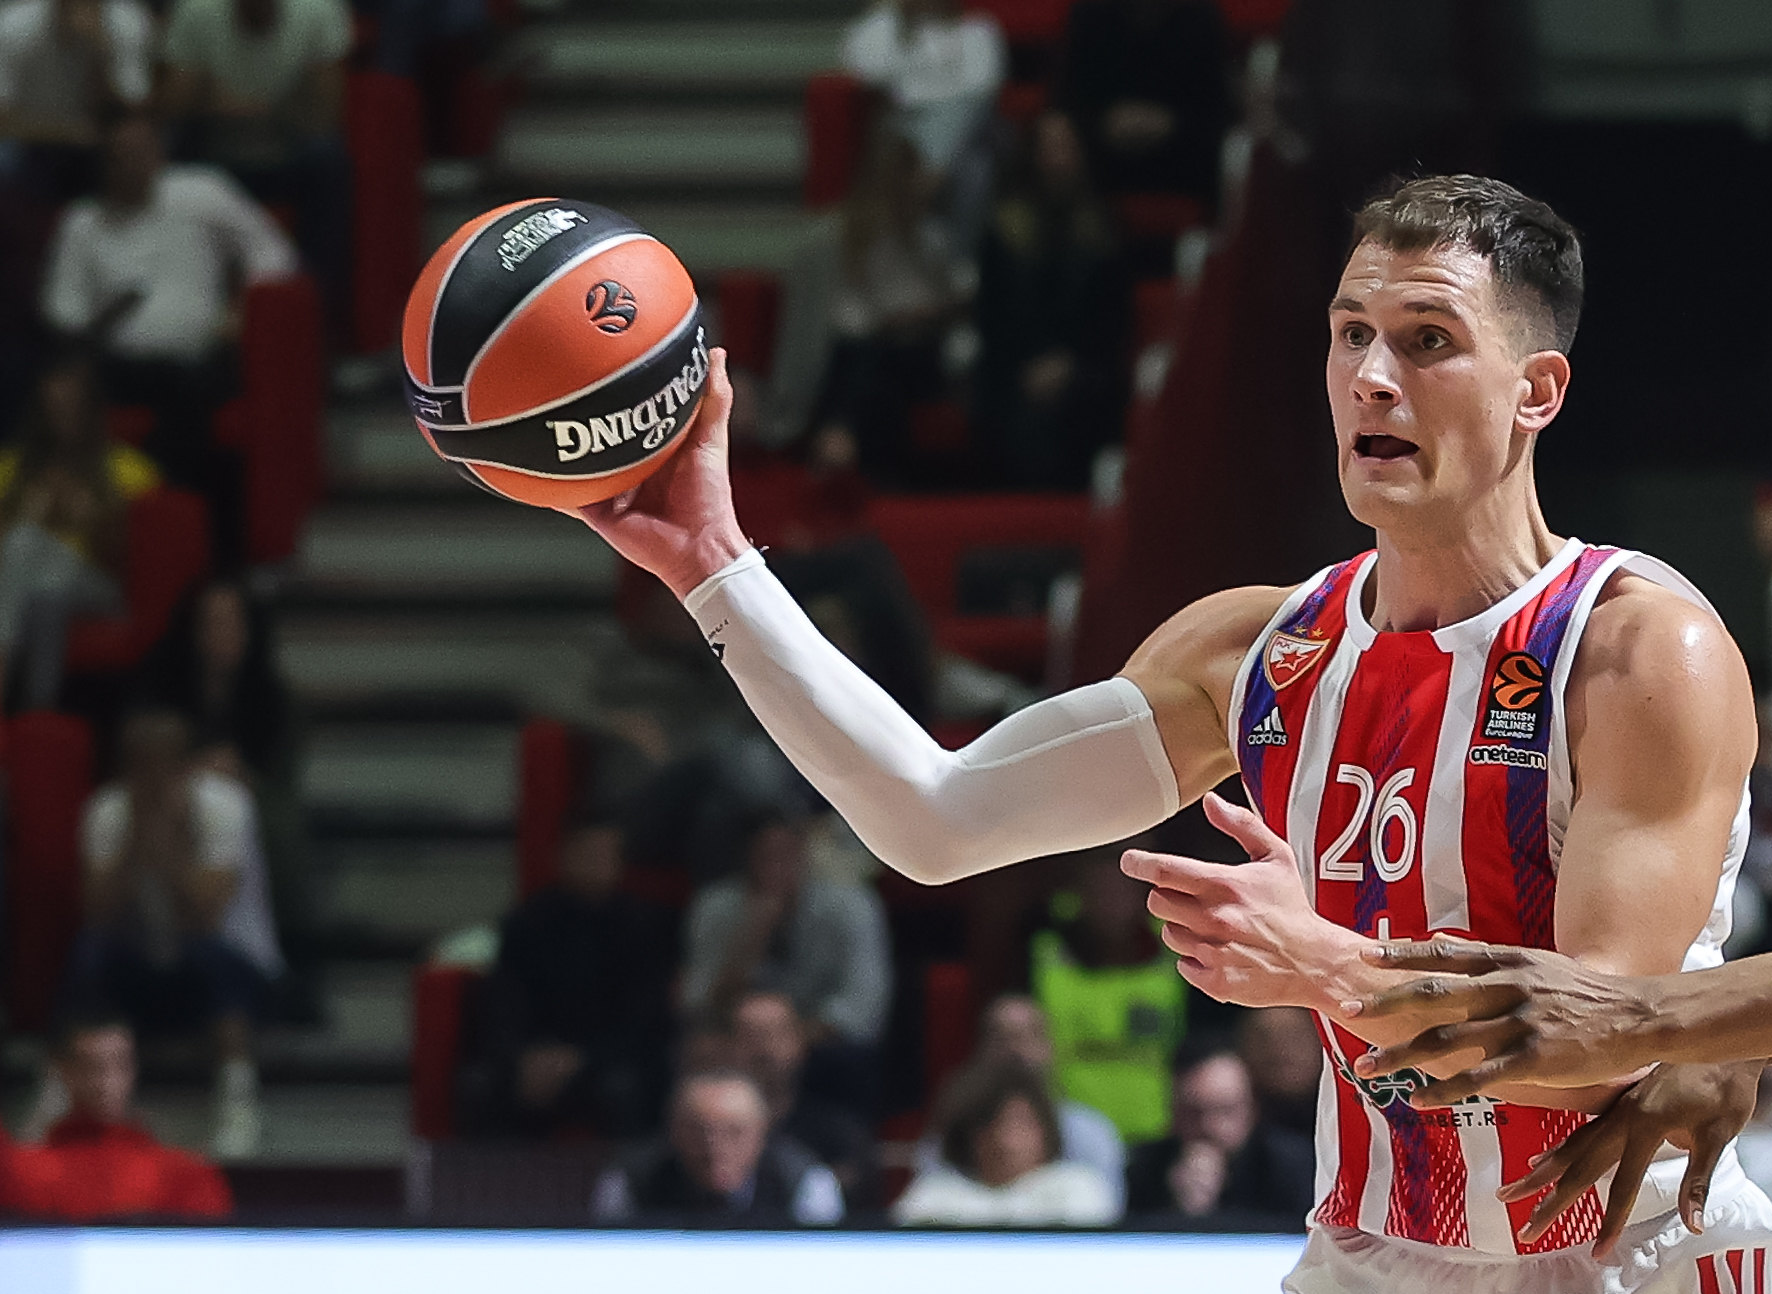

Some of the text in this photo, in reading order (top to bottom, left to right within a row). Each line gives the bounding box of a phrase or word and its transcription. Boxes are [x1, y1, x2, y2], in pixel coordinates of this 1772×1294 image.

[1490, 709, 1536, 723] TURKISH
[1487, 719, 1535, 732] AIRLINES
[1319, 763, 1417, 882] 26
